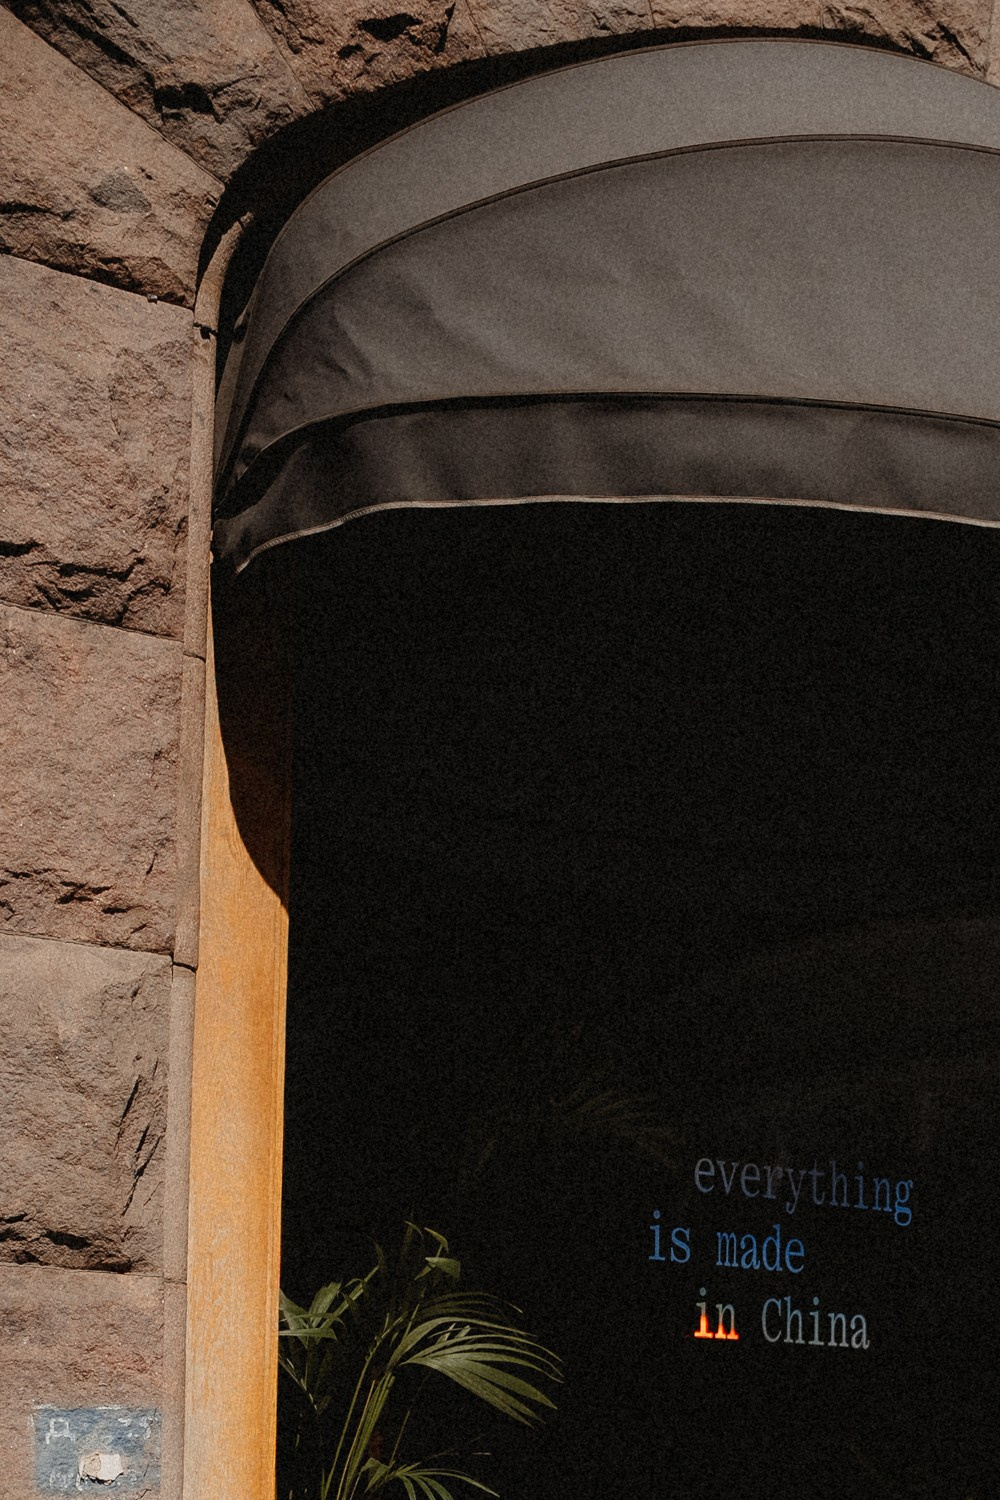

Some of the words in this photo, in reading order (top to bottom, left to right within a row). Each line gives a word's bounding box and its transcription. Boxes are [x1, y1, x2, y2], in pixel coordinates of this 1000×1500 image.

[694, 1157, 913, 1226] everything
[648, 1209, 691, 1263] is
[716, 1223, 805, 1273] made
[694, 1287, 739, 1340] in
[761, 1296, 870, 1349] China
